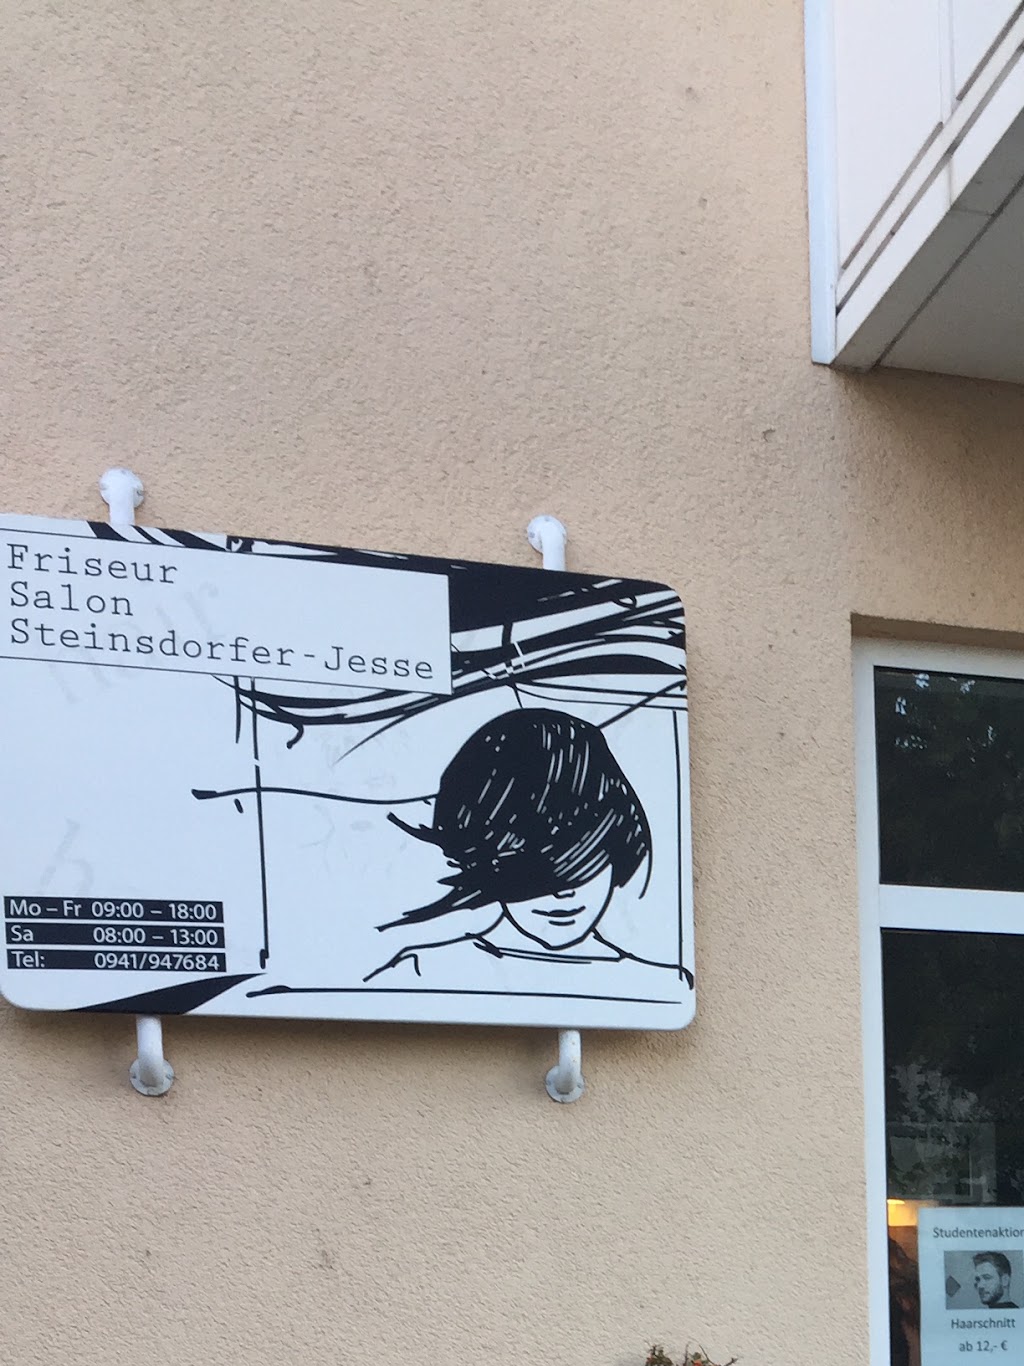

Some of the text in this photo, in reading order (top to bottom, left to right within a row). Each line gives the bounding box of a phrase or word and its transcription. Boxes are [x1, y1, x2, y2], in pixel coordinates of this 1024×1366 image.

[7, 544, 179, 586] Friseur
[10, 582, 134, 619] Salon
[10, 618, 434, 681] Steinsdorfer-Jesse
[9, 899, 42, 918] Mo
[62, 900, 82, 918] Fr
[91, 902, 145, 919] 09:00
[168, 902, 217, 921] 18:00
[11, 925, 35, 943] Sa
[93, 927, 145, 945] 08:00
[169, 928, 219, 946] 13:00
[12, 950, 220, 971] Tel: 0941/947684
[950, 1318, 1016, 1330] Haarschnitt
[959, 1341, 1009, 1354] ab 12,- €
